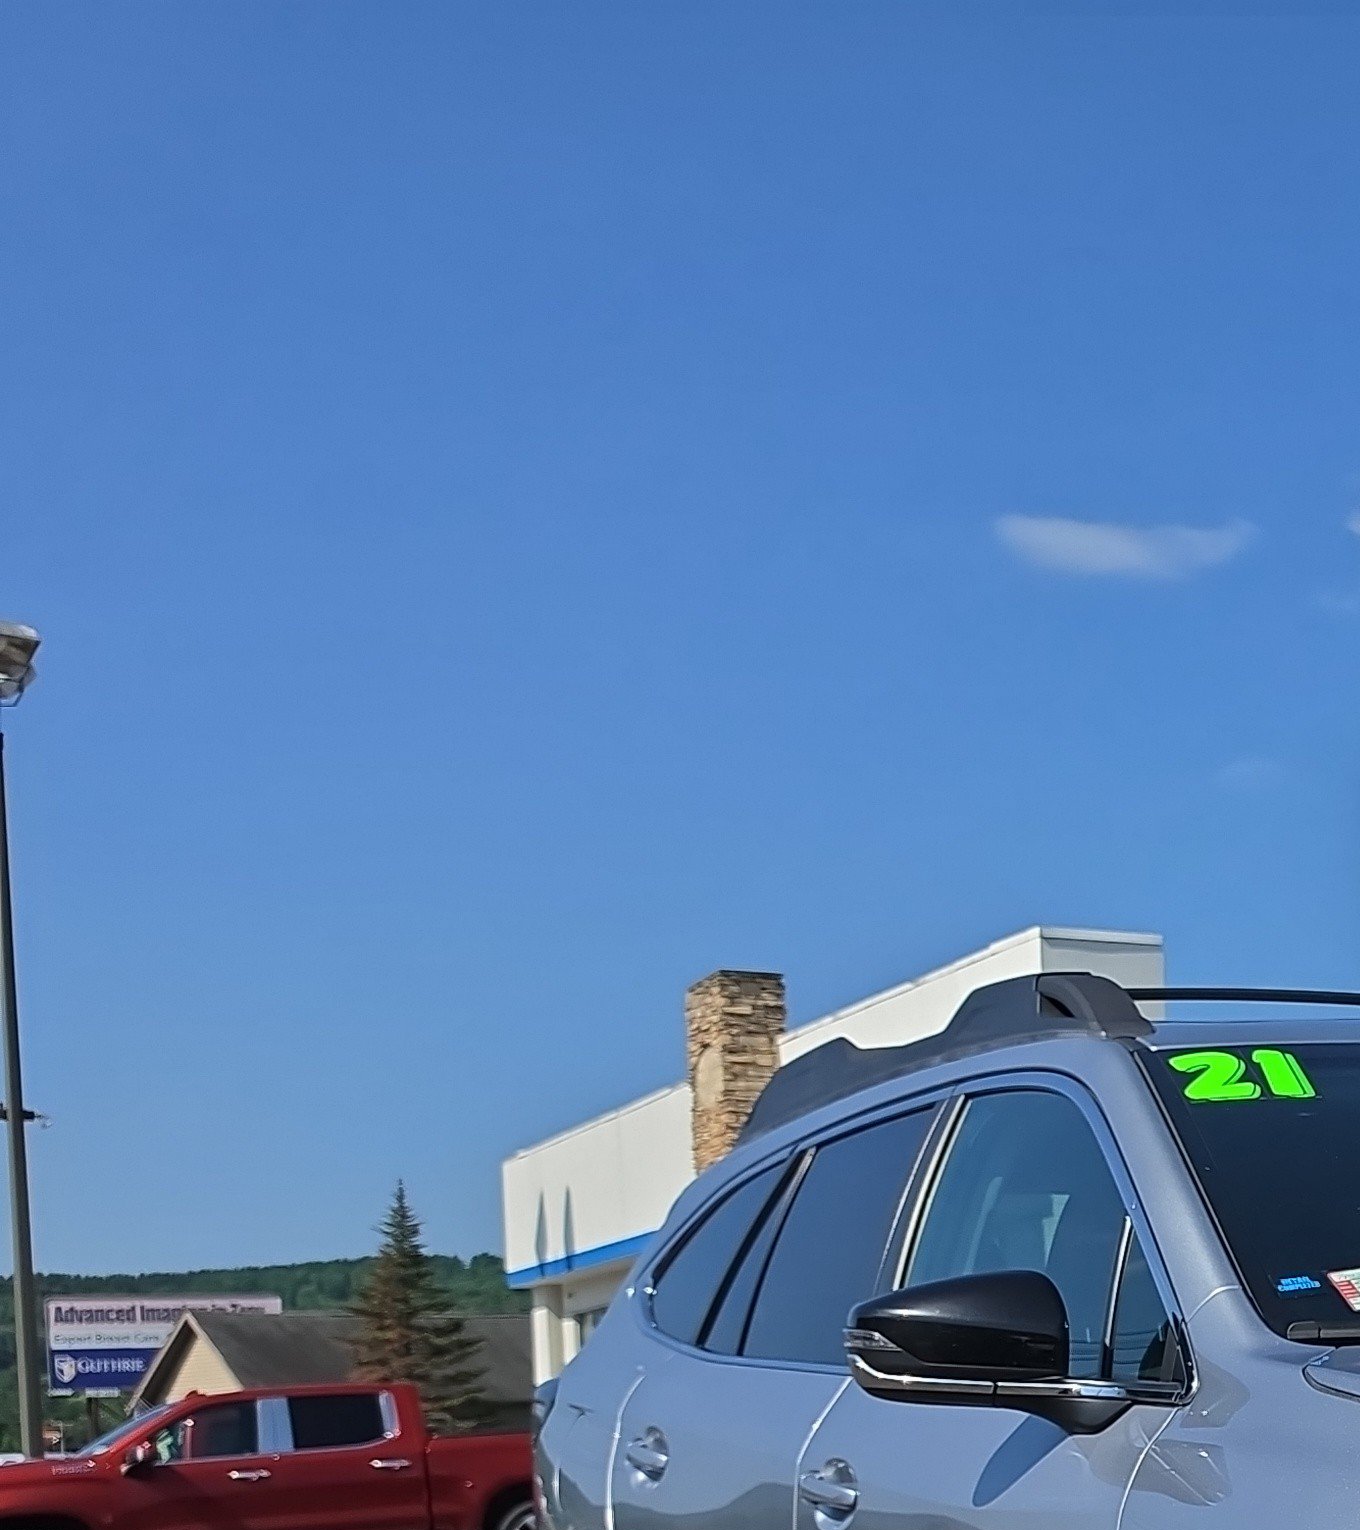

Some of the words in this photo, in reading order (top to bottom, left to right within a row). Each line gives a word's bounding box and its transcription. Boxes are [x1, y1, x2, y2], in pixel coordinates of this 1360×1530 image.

[1168, 1049, 1317, 1102] 21
[54, 1304, 136, 1324] Advanced
[140, 1304, 208, 1322] Imag
[77, 1356, 148, 1374] GUTHRIE
